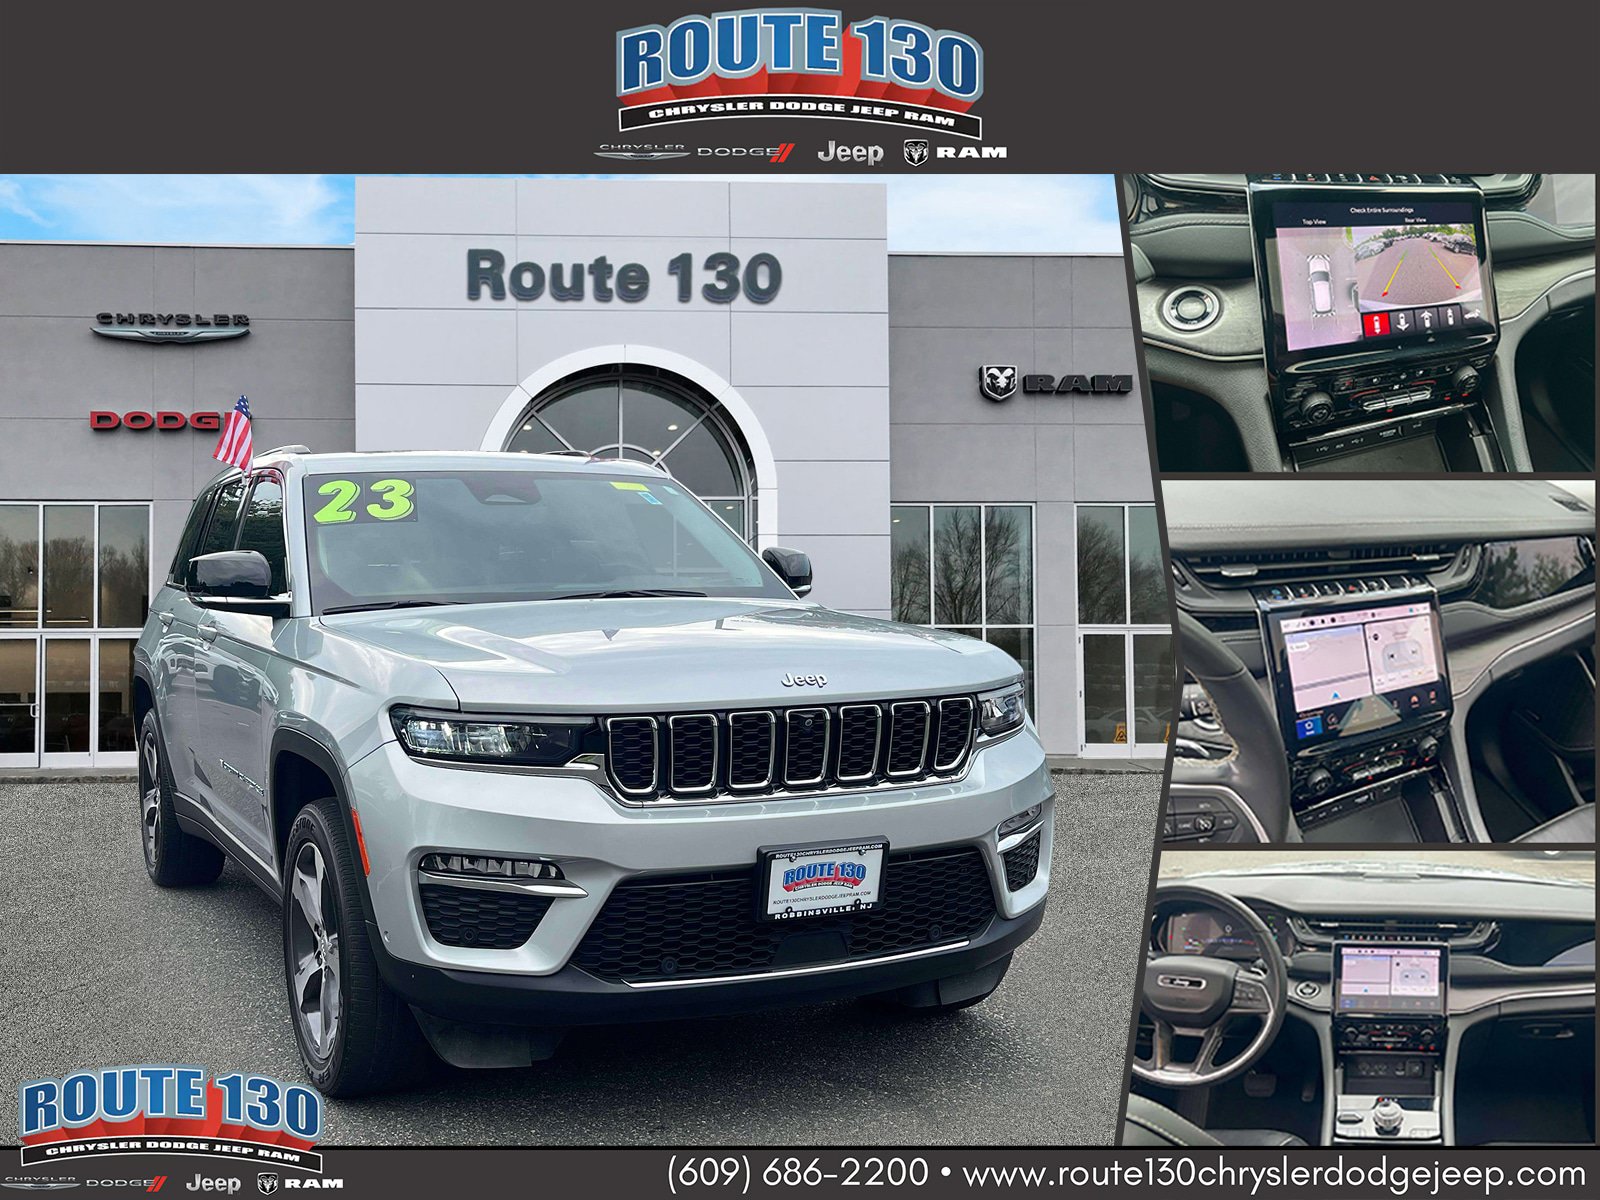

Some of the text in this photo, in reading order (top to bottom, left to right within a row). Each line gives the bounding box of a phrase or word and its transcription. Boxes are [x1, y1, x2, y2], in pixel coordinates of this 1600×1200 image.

[1349, 206, 1366, 214] Check
[467, 248, 782, 304] Route 130
[96, 312, 250, 326] CHRYSLER
[1023, 375, 1133, 394] RAM
[313, 479, 415, 524] 23
[781, 673, 828, 689] Jeep
[784, 862, 866, 885] ROUTE 130
[774, 904, 856, 919] ROBBINSVILLE,
